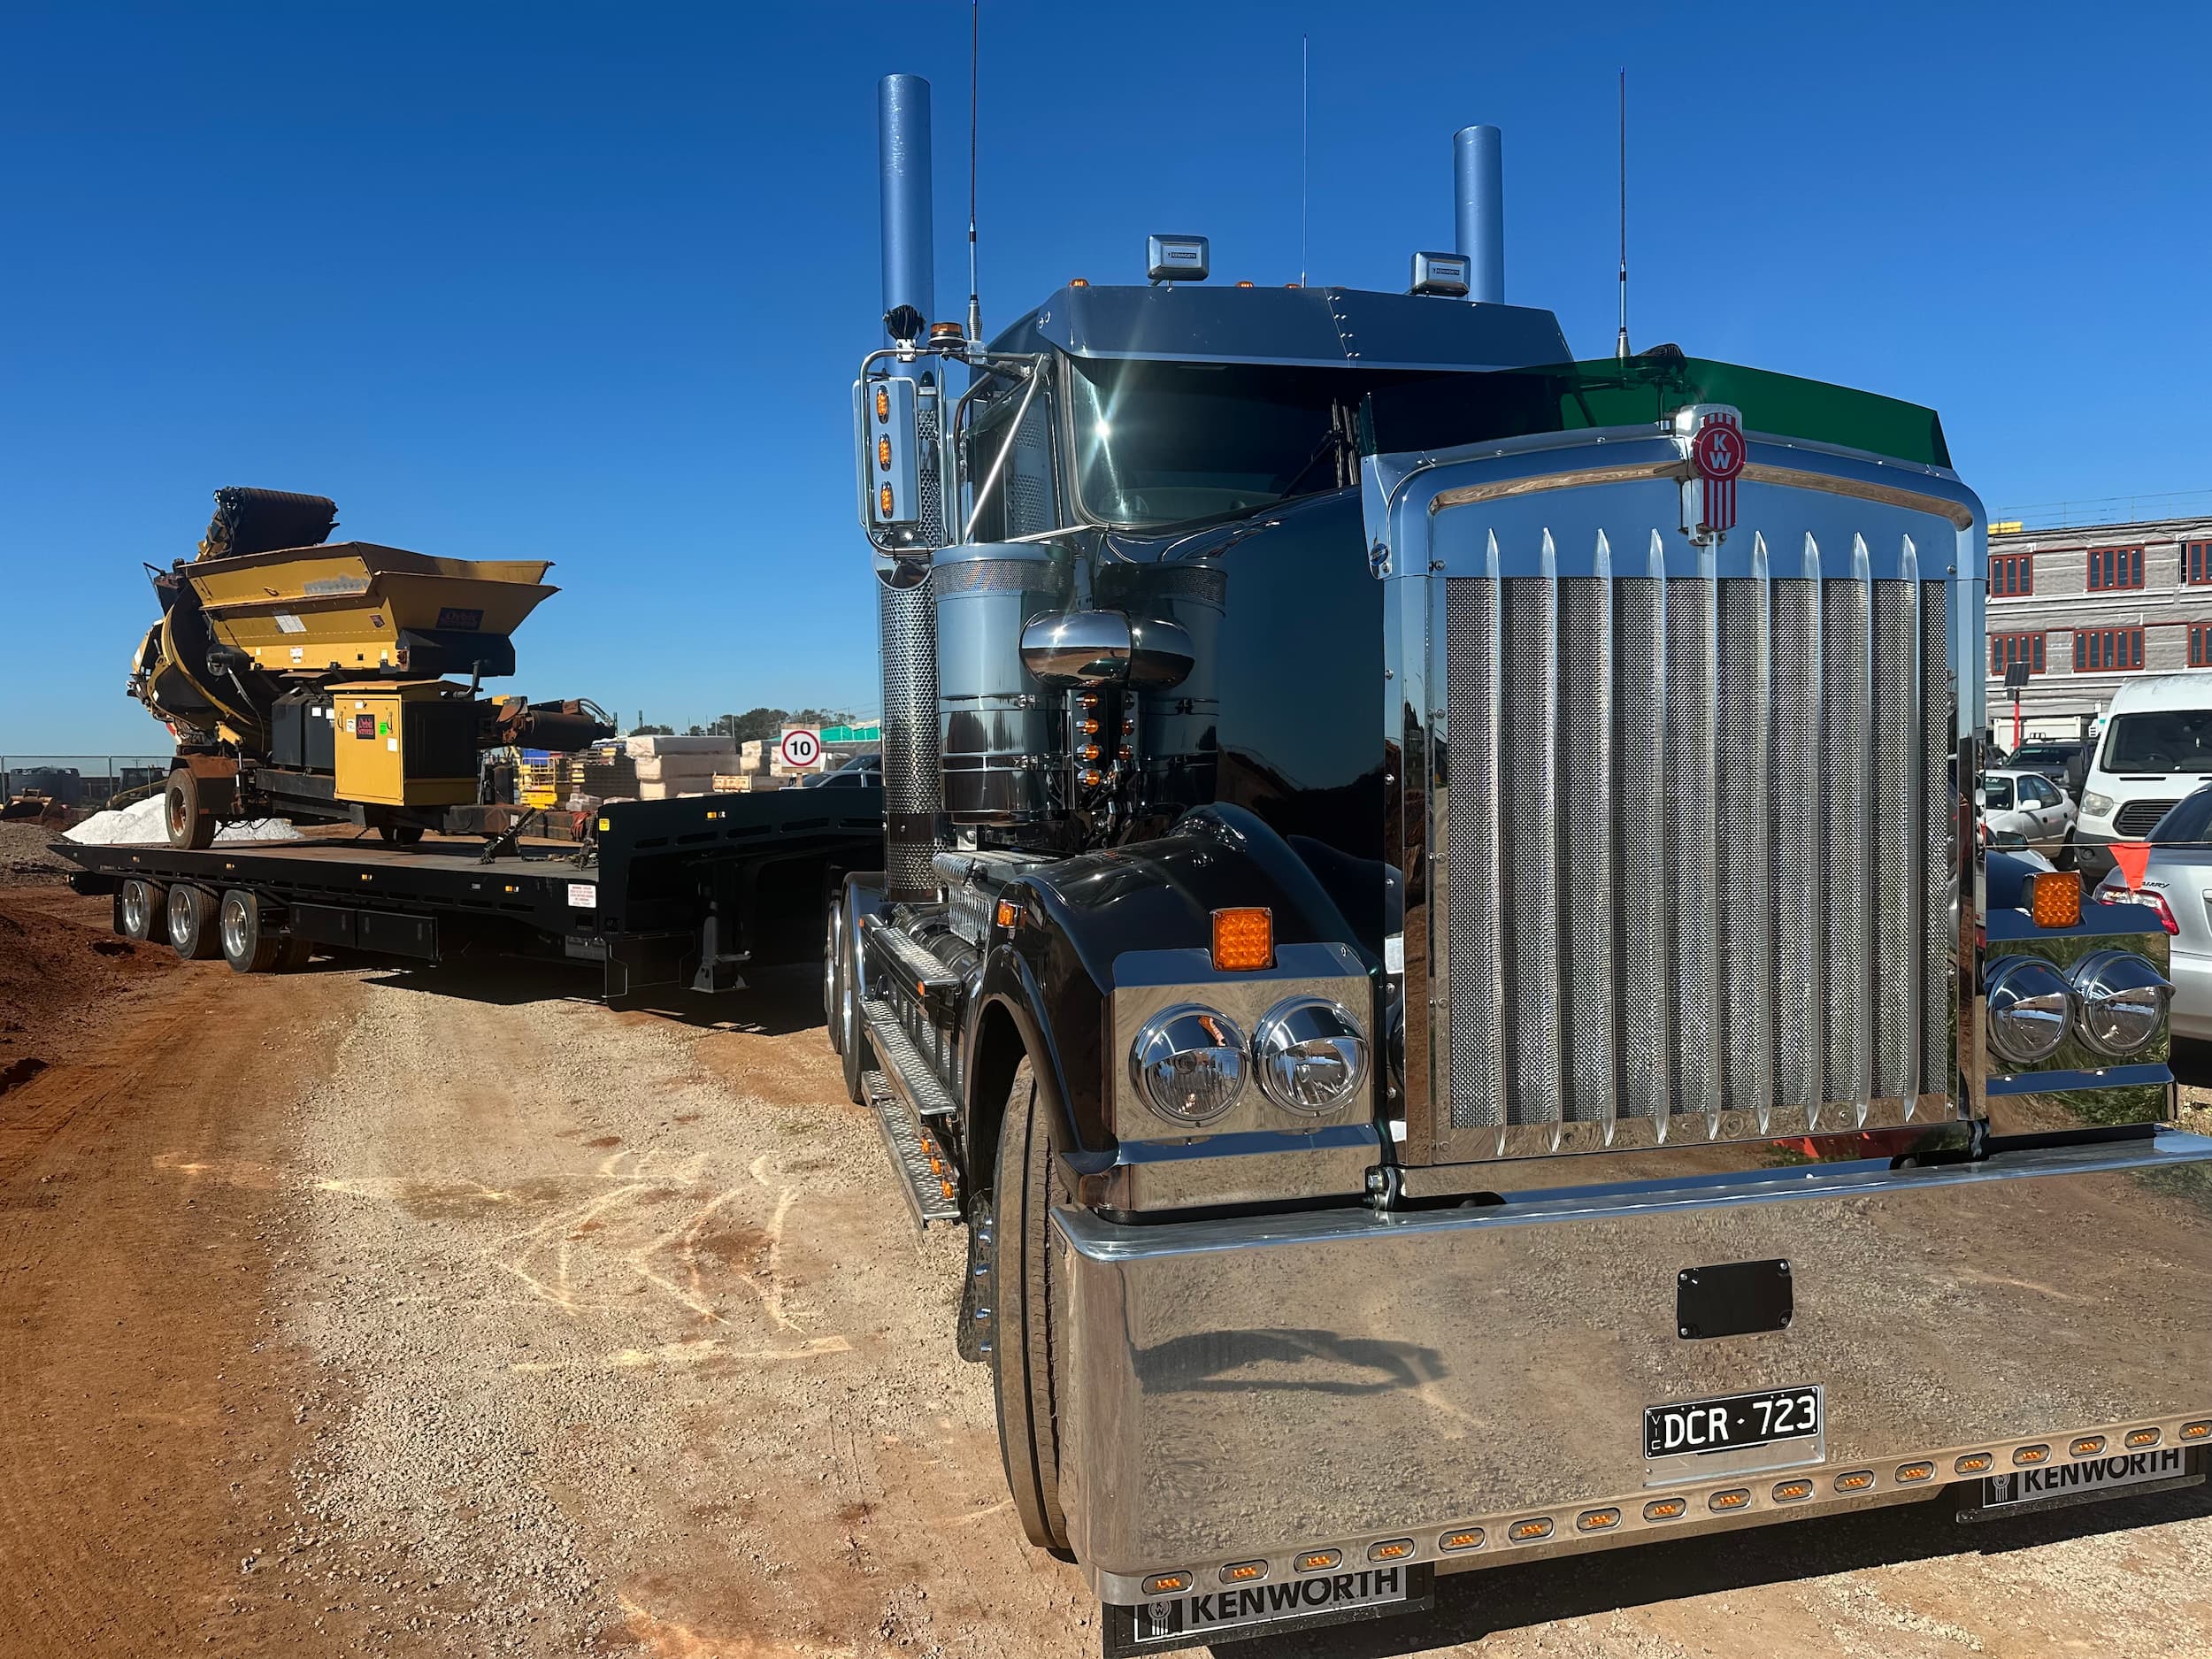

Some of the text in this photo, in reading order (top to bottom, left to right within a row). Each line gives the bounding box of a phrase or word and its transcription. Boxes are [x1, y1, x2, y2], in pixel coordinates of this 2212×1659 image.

[790, 741, 811, 757] 10
[1664, 1395, 1816, 1448] DCR 723
[2024, 1448, 2179, 1493] KENWORTH
[1191, 1566, 1398, 1624] KENWORTH
